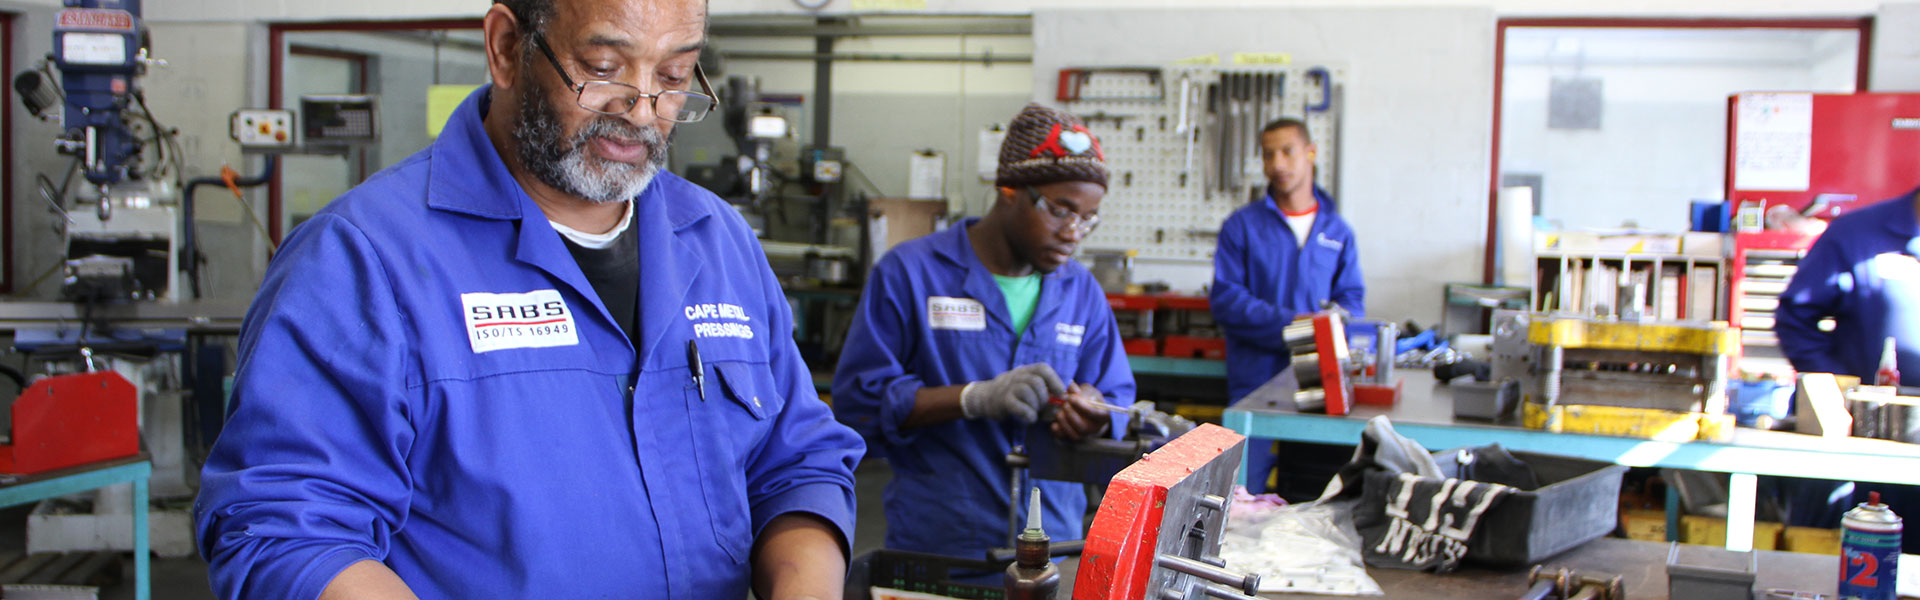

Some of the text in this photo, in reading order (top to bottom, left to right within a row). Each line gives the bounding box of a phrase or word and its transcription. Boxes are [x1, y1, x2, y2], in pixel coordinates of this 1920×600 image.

[472, 301, 564, 320] SABS
[684, 303, 720, 321] CAPE
[476, 324, 569, 340] ISO/TS 16949
[693, 322, 754, 339] PRESSINGS
